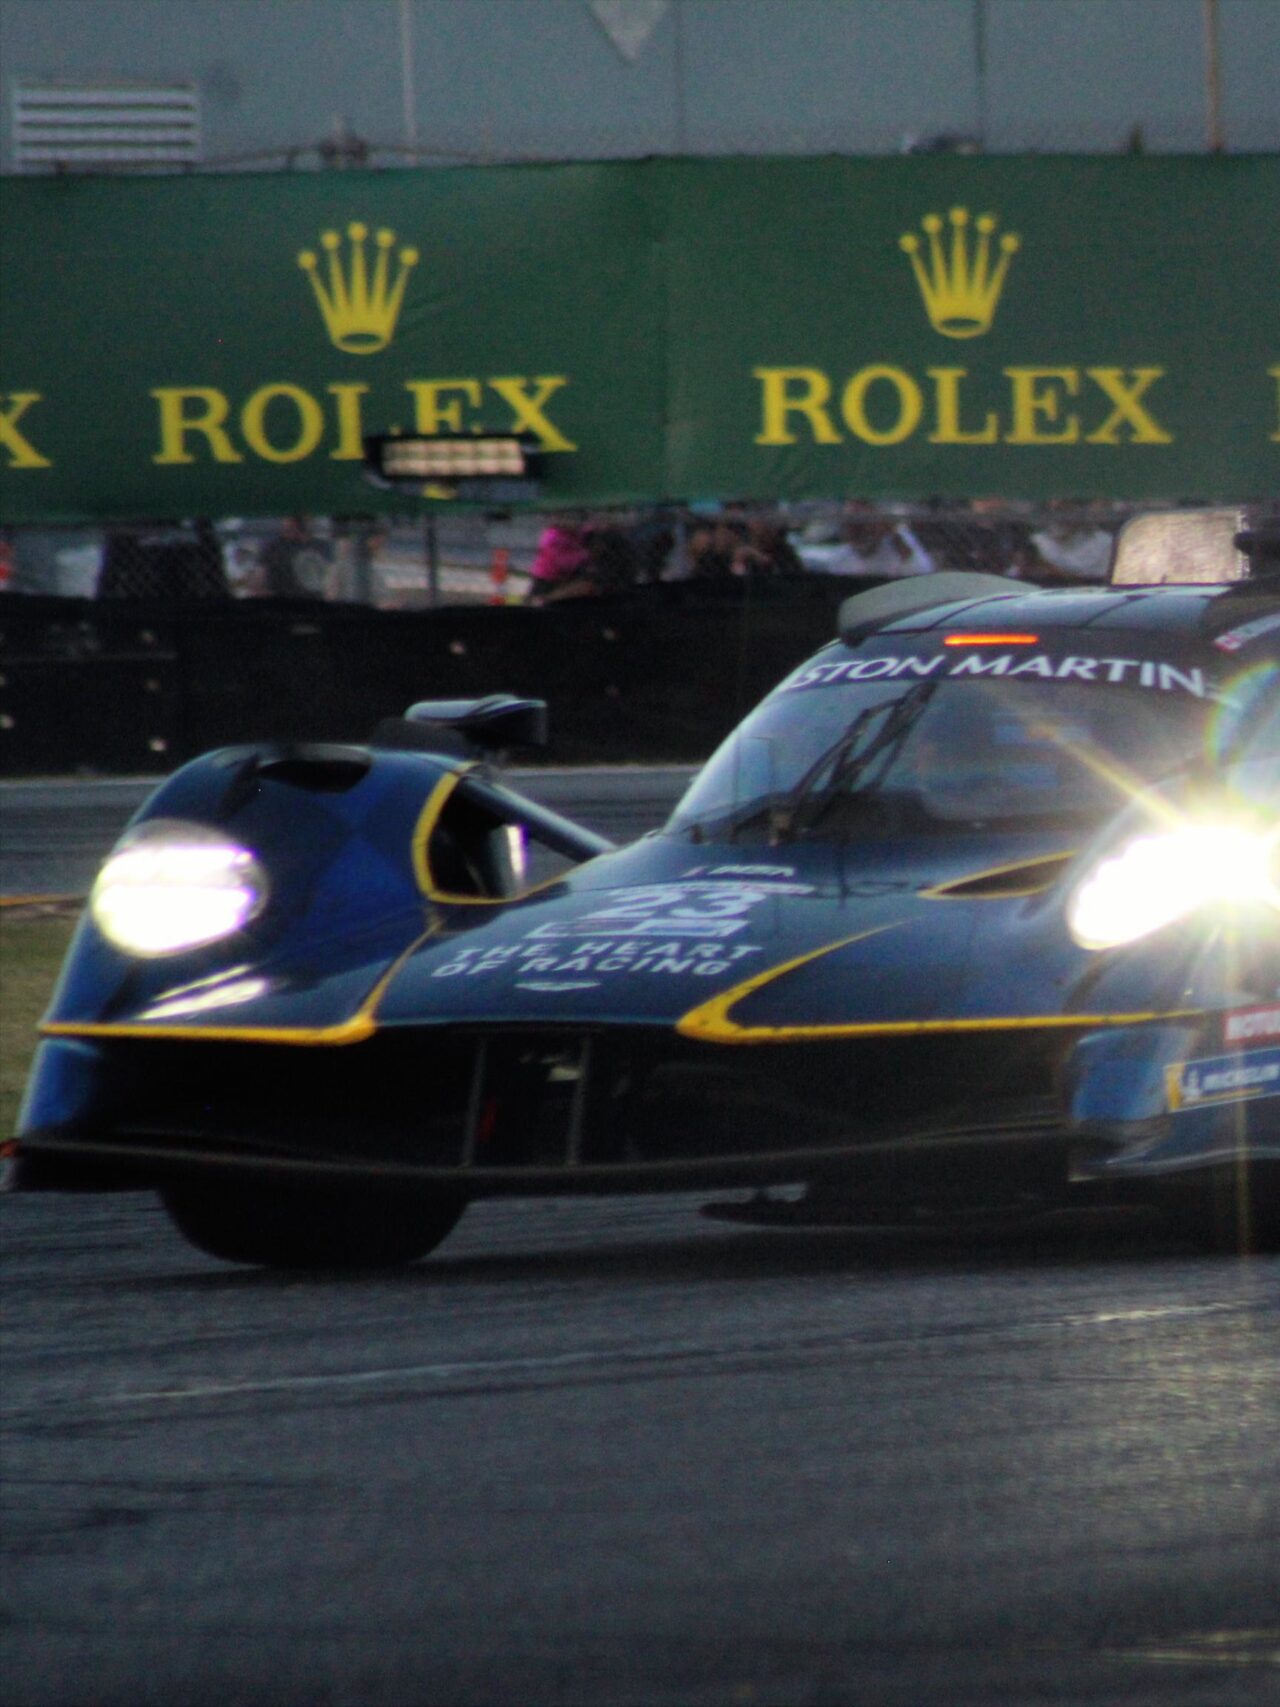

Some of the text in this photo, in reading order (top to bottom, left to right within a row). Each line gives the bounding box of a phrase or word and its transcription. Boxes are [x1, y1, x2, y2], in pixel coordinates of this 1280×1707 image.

[753, 365, 1174, 447] ROLEX
[786, 653, 1206, 697] STON MARTIN
[578, 888, 768, 920] 23
[431, 958, 733, 977] OF RACING
[451, 941, 765, 962] THE HEART
